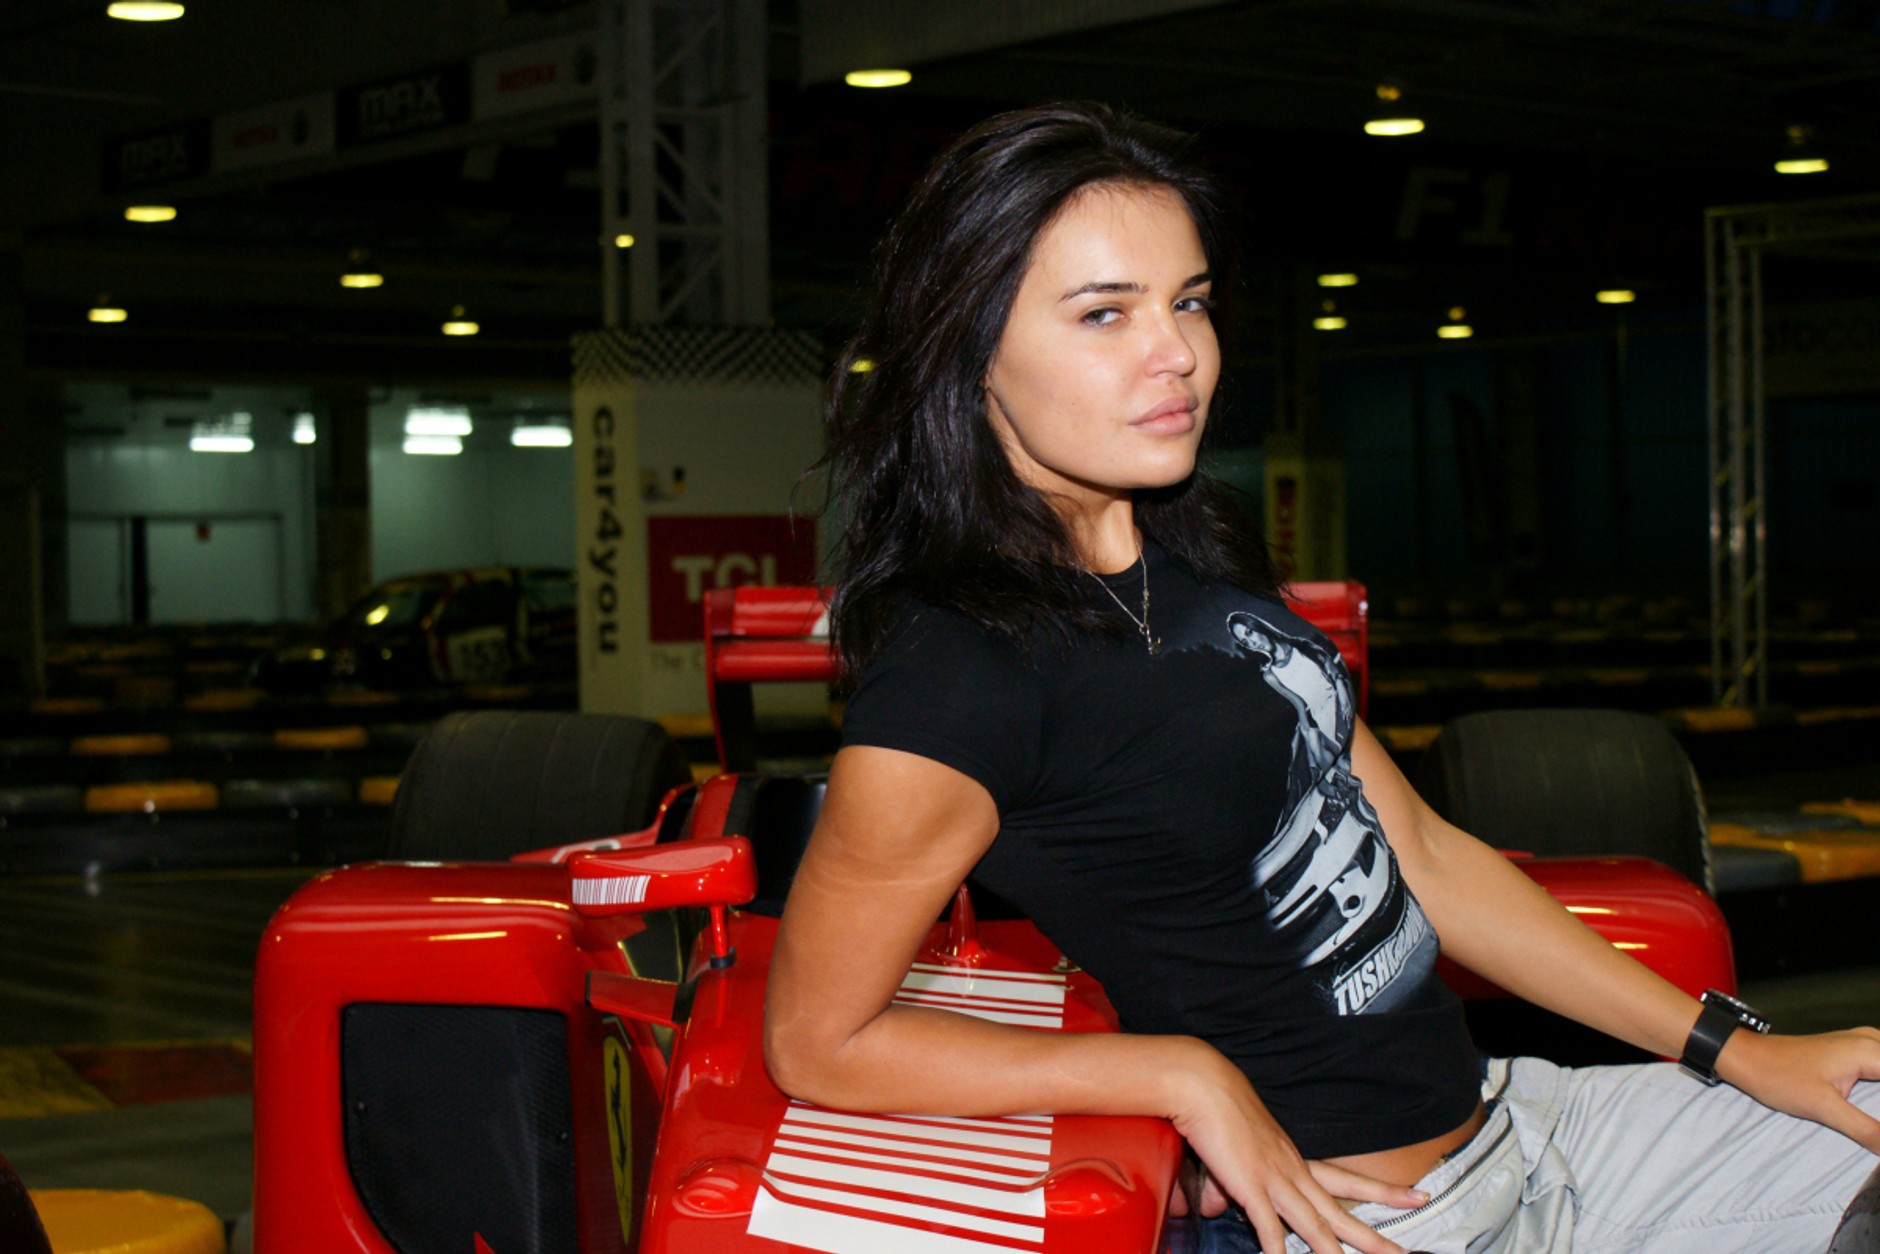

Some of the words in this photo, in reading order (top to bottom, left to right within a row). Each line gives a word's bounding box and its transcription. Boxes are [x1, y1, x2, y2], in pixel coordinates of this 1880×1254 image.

[359, 74, 444, 123] MAX
[1392, 162, 1518, 249] F1
[591, 406, 621, 653] car4you
